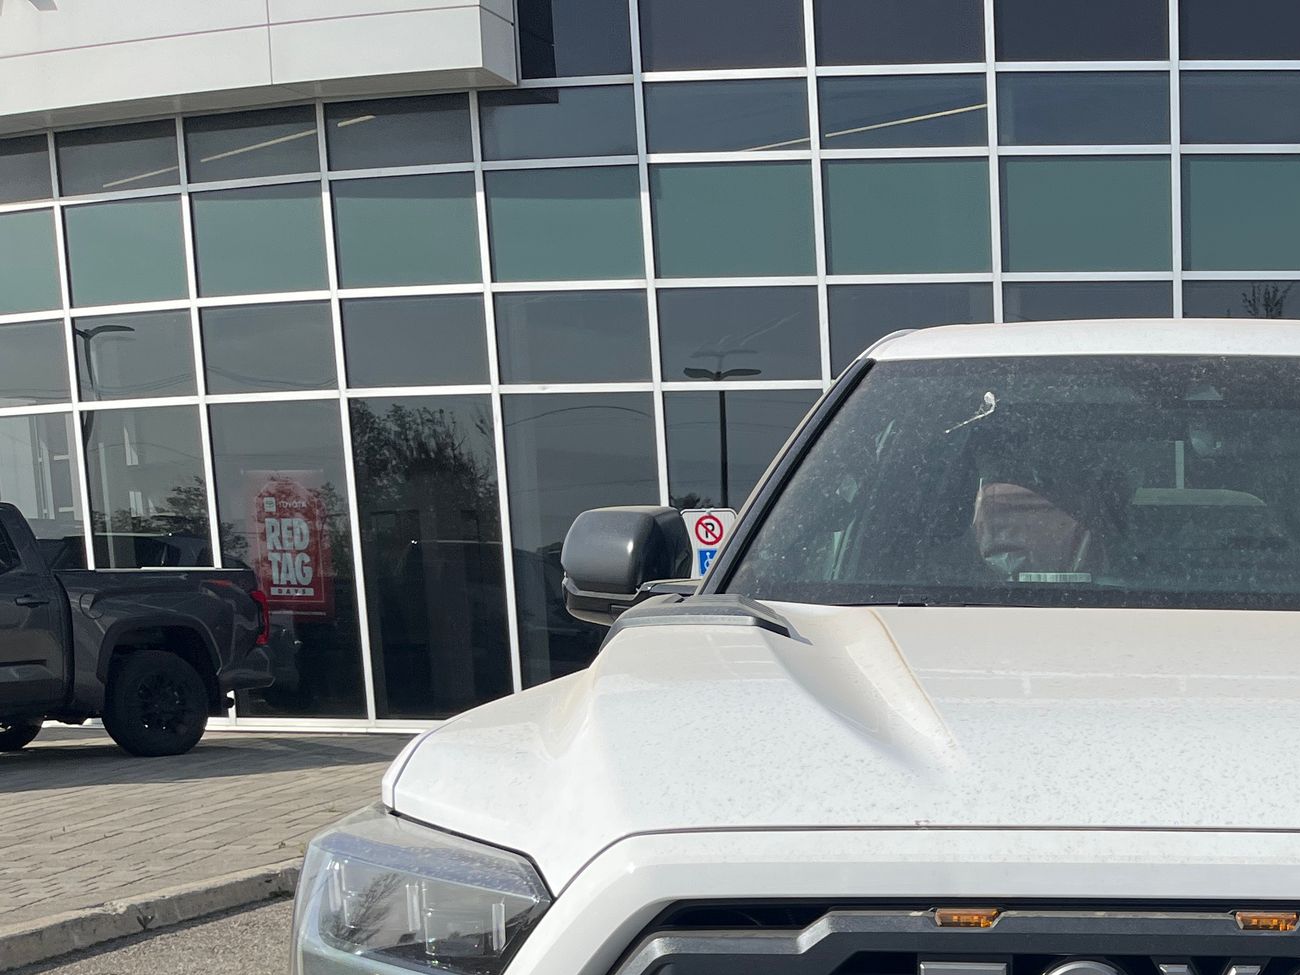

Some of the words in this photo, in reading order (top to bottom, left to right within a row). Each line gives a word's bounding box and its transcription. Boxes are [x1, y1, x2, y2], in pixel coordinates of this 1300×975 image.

[279, 500, 307, 509] TOYOTA
[265, 517, 310, 551] RED
[268, 552, 313, 586] TAG
